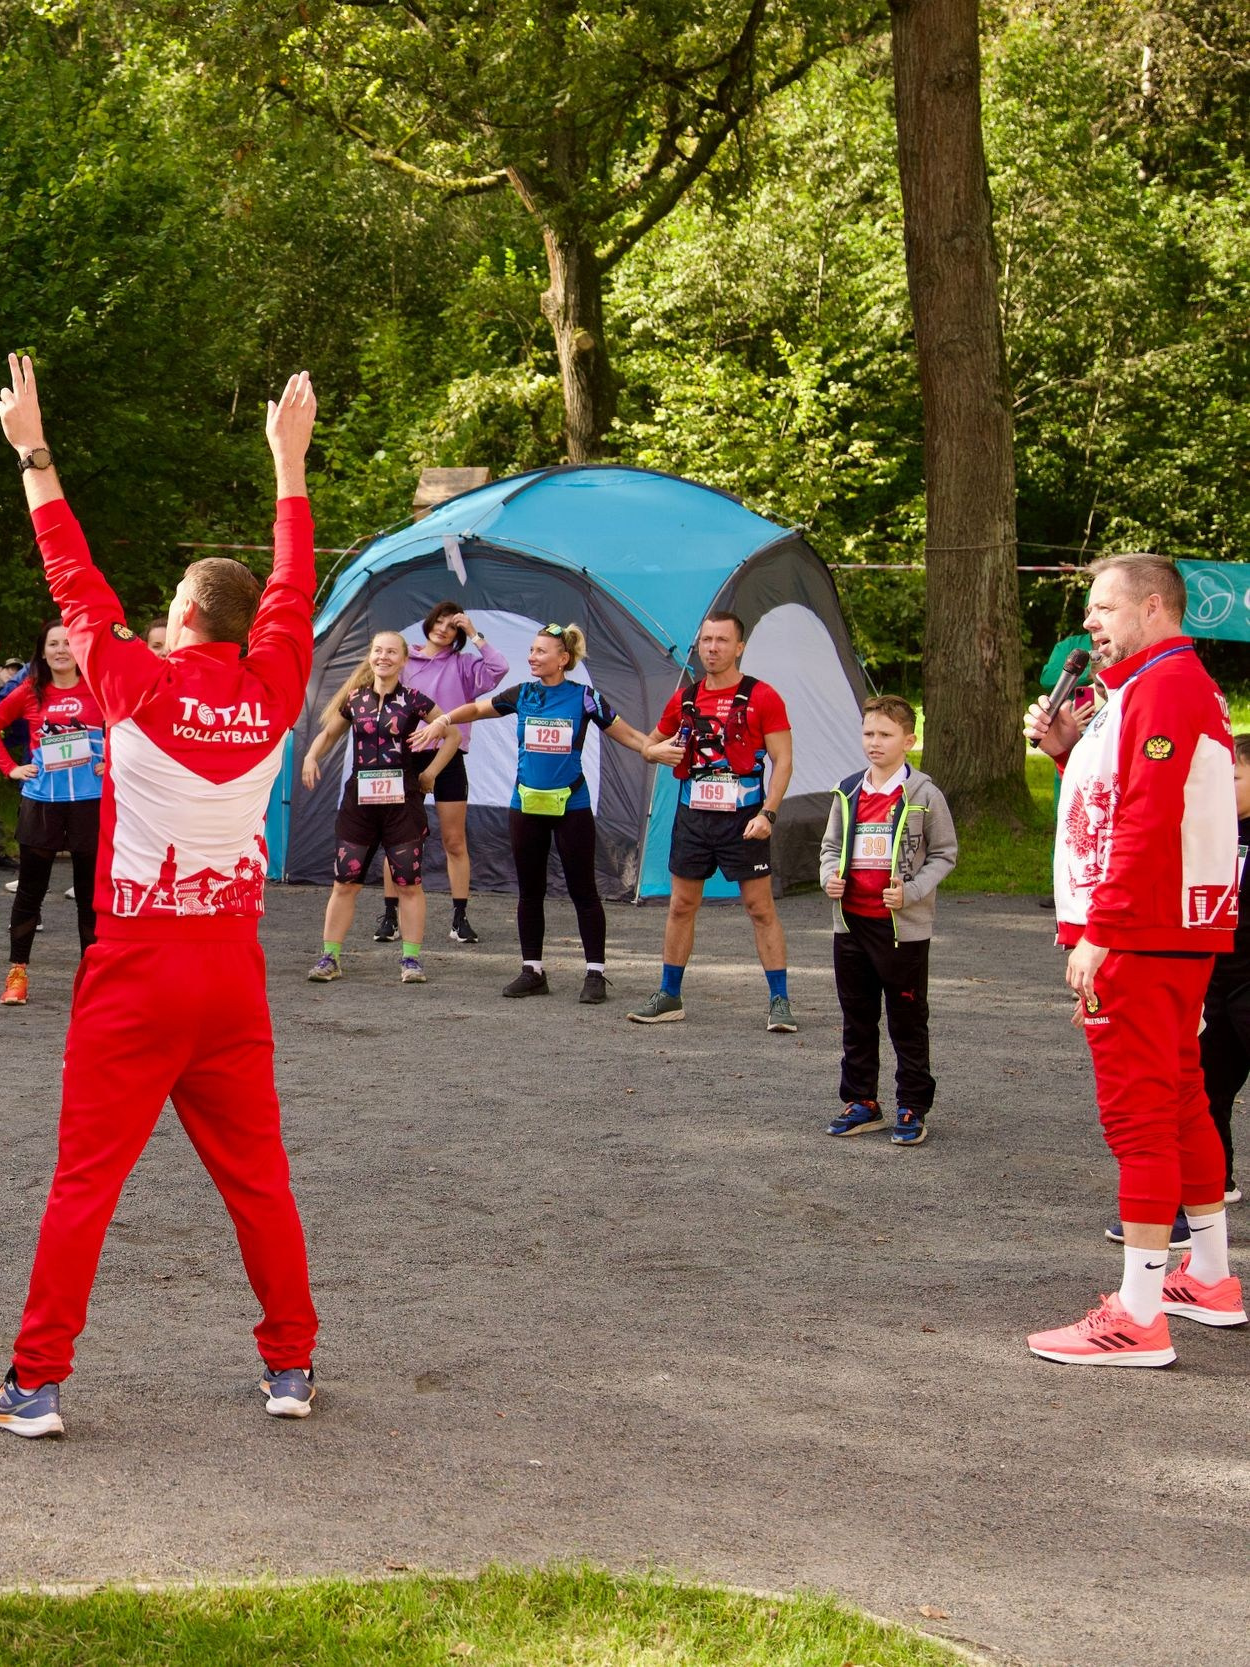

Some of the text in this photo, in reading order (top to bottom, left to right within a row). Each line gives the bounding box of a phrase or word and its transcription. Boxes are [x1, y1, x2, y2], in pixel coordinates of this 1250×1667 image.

[48, 704, 78, 712] БЕГИ
[172, 722, 270, 743] VOLLEYBALL
[536, 728, 560, 744] 129
[59, 744, 72, 759] 17
[370, 780, 392, 794] 127
[699, 784, 724, 800] 169
[862, 836, 886, 856] 39
